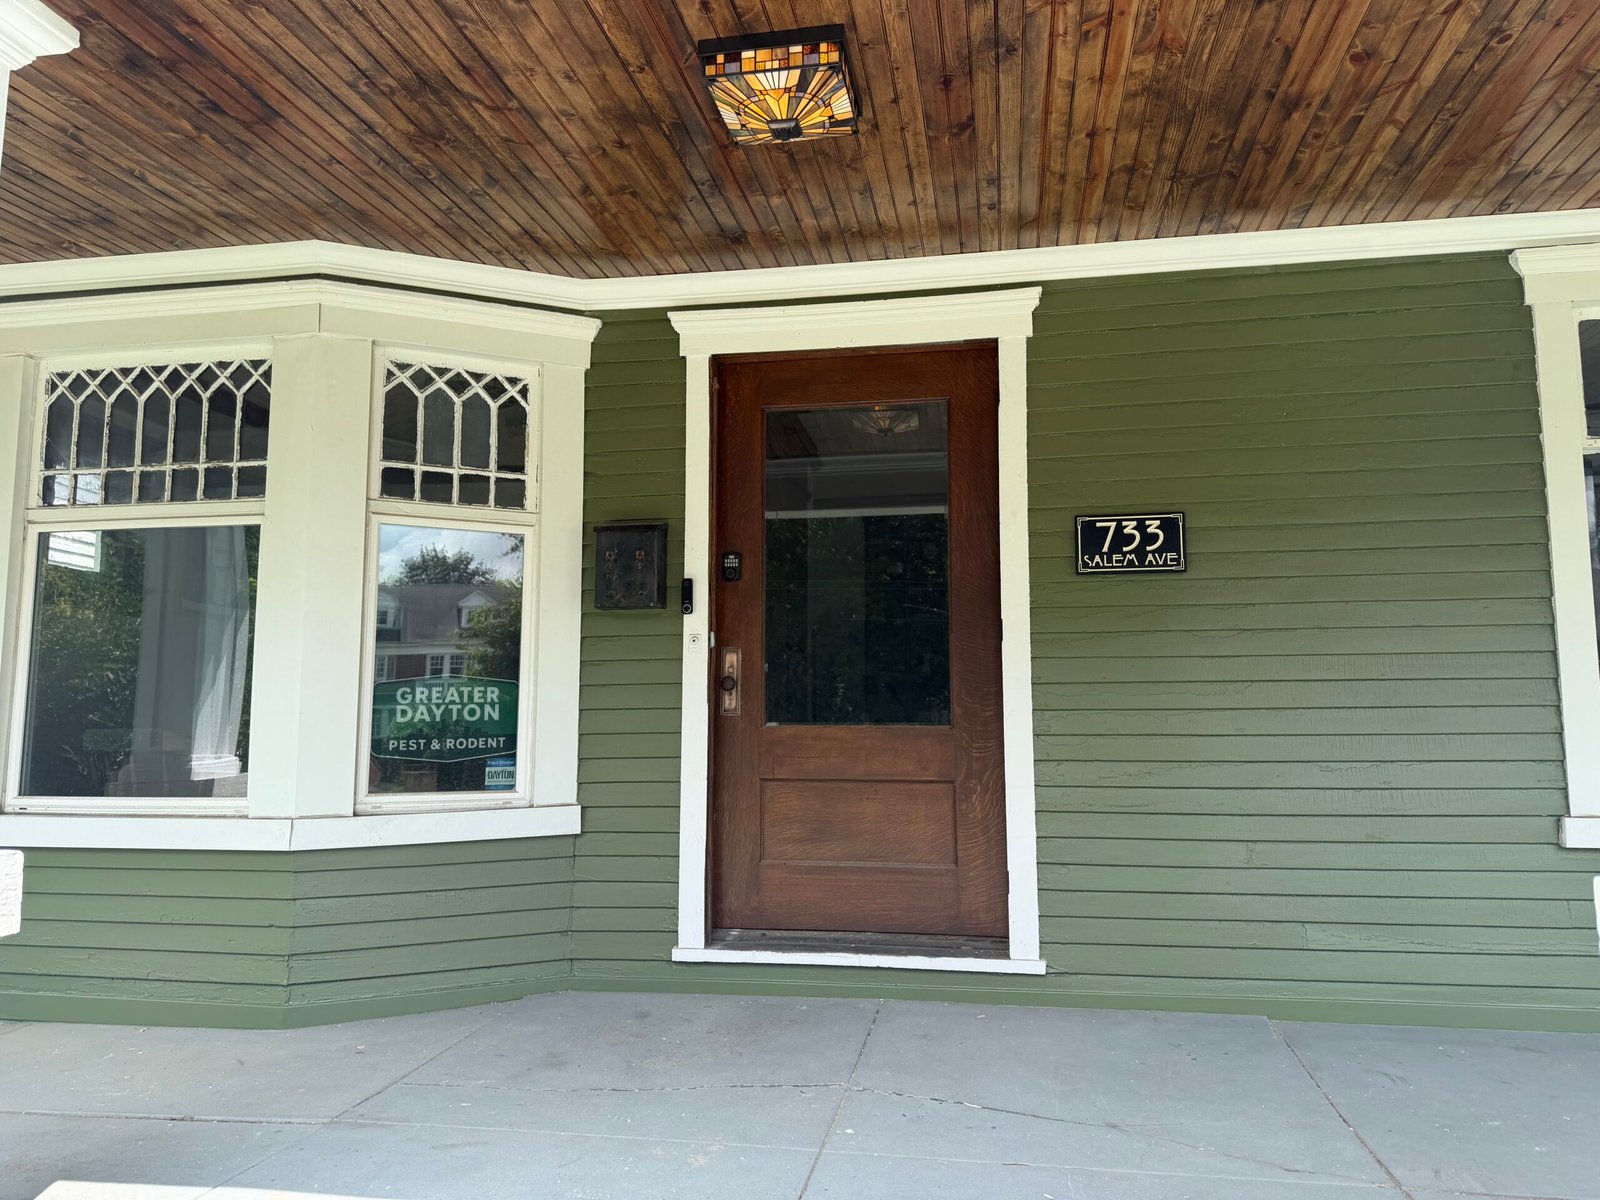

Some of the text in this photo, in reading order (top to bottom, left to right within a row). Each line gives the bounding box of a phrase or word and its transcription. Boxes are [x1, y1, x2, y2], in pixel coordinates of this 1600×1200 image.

[1095, 519, 1165, 553] 733
[1083, 552, 1179, 567] SALEM AVE
[396, 686, 500, 704] GREATER
[395, 703, 500, 723] DAYTON
[388, 737, 506, 751] PEST & RODENT
[487, 769, 515, 780] DAYTON
